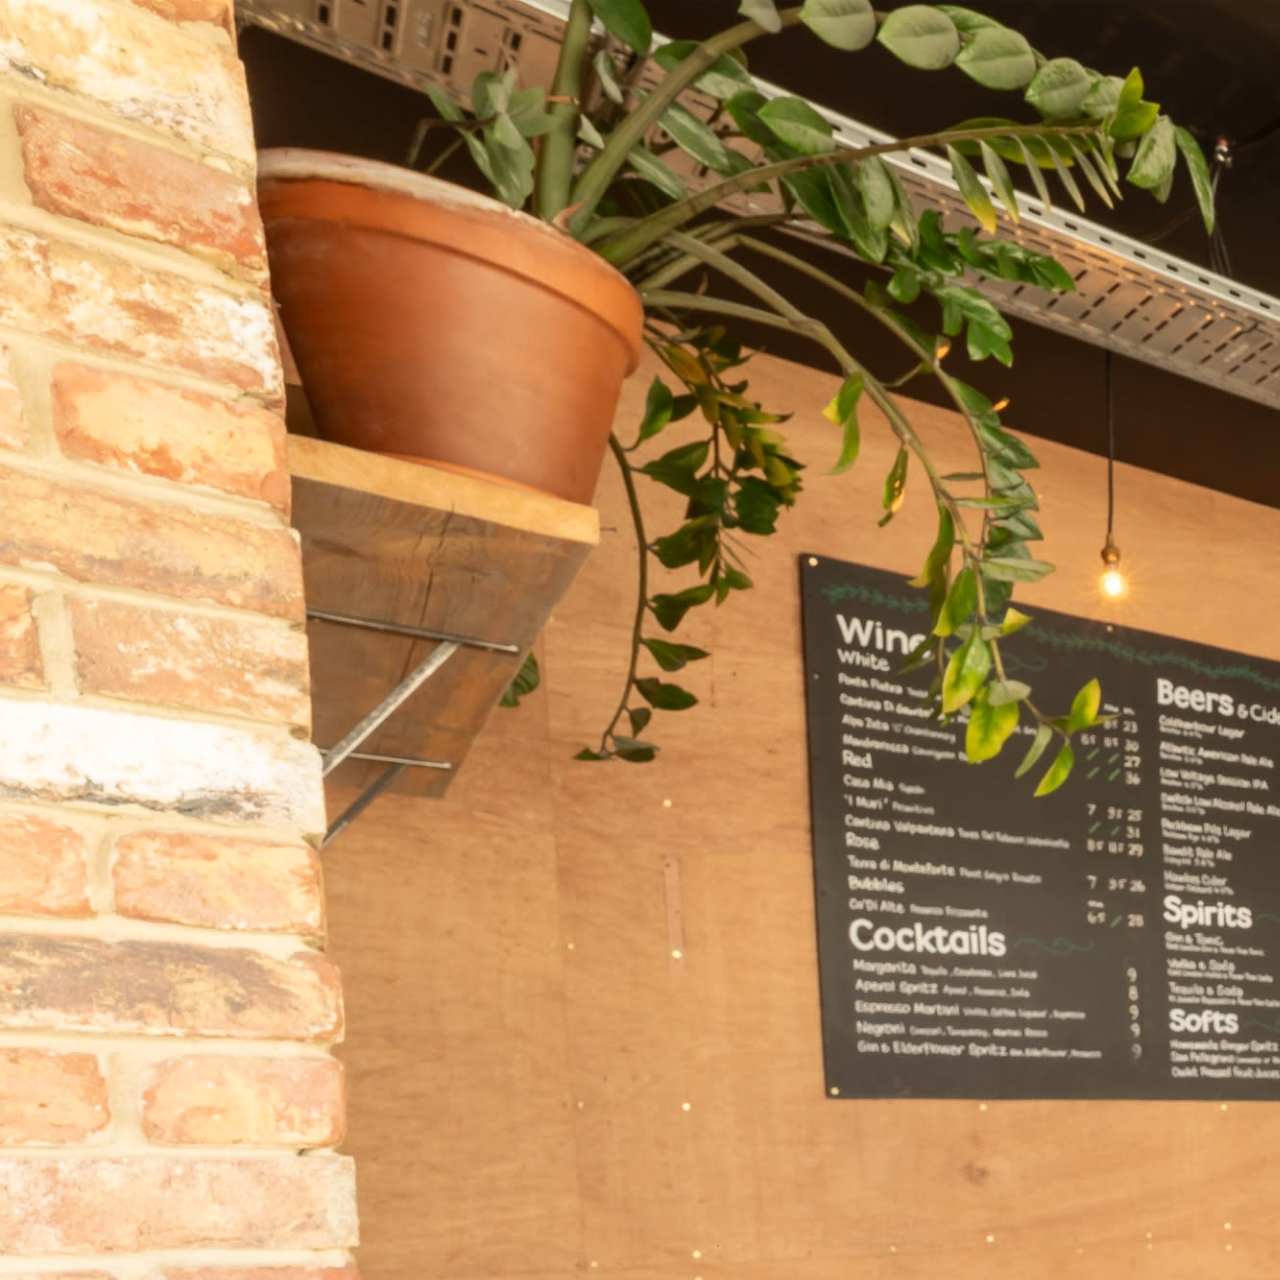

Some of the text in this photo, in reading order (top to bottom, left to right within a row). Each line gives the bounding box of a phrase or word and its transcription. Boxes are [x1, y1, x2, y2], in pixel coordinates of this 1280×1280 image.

[837, 649, 890, 671] White
[1157, 677, 1235, 717] Beers
[1237, 703, 1249, 719] &
[842, 750, 873, 768] Red
[1086, 804, 1096, 815] 7
[848, 875, 905, 894] Bubbles
[1086, 874, 1097, 889] 7
[1163, 895, 1253, 929] Spirits
[849, 918, 1007, 957] Cocktails
[853, 958, 917, 976] Margarita
[1126, 967, 1137, 982] 9
[855, 978, 896, 993] Aperol
[899, 981, 938, 996] Spritz
[854, 999, 911, 1015] Espresso
[1128, 1004, 1140, 1020] 9
[856, 1020, 905, 1038] Negroni
[1129, 1022, 1141, 1038] 9
[1168, 1008, 1240, 1035] Softs
